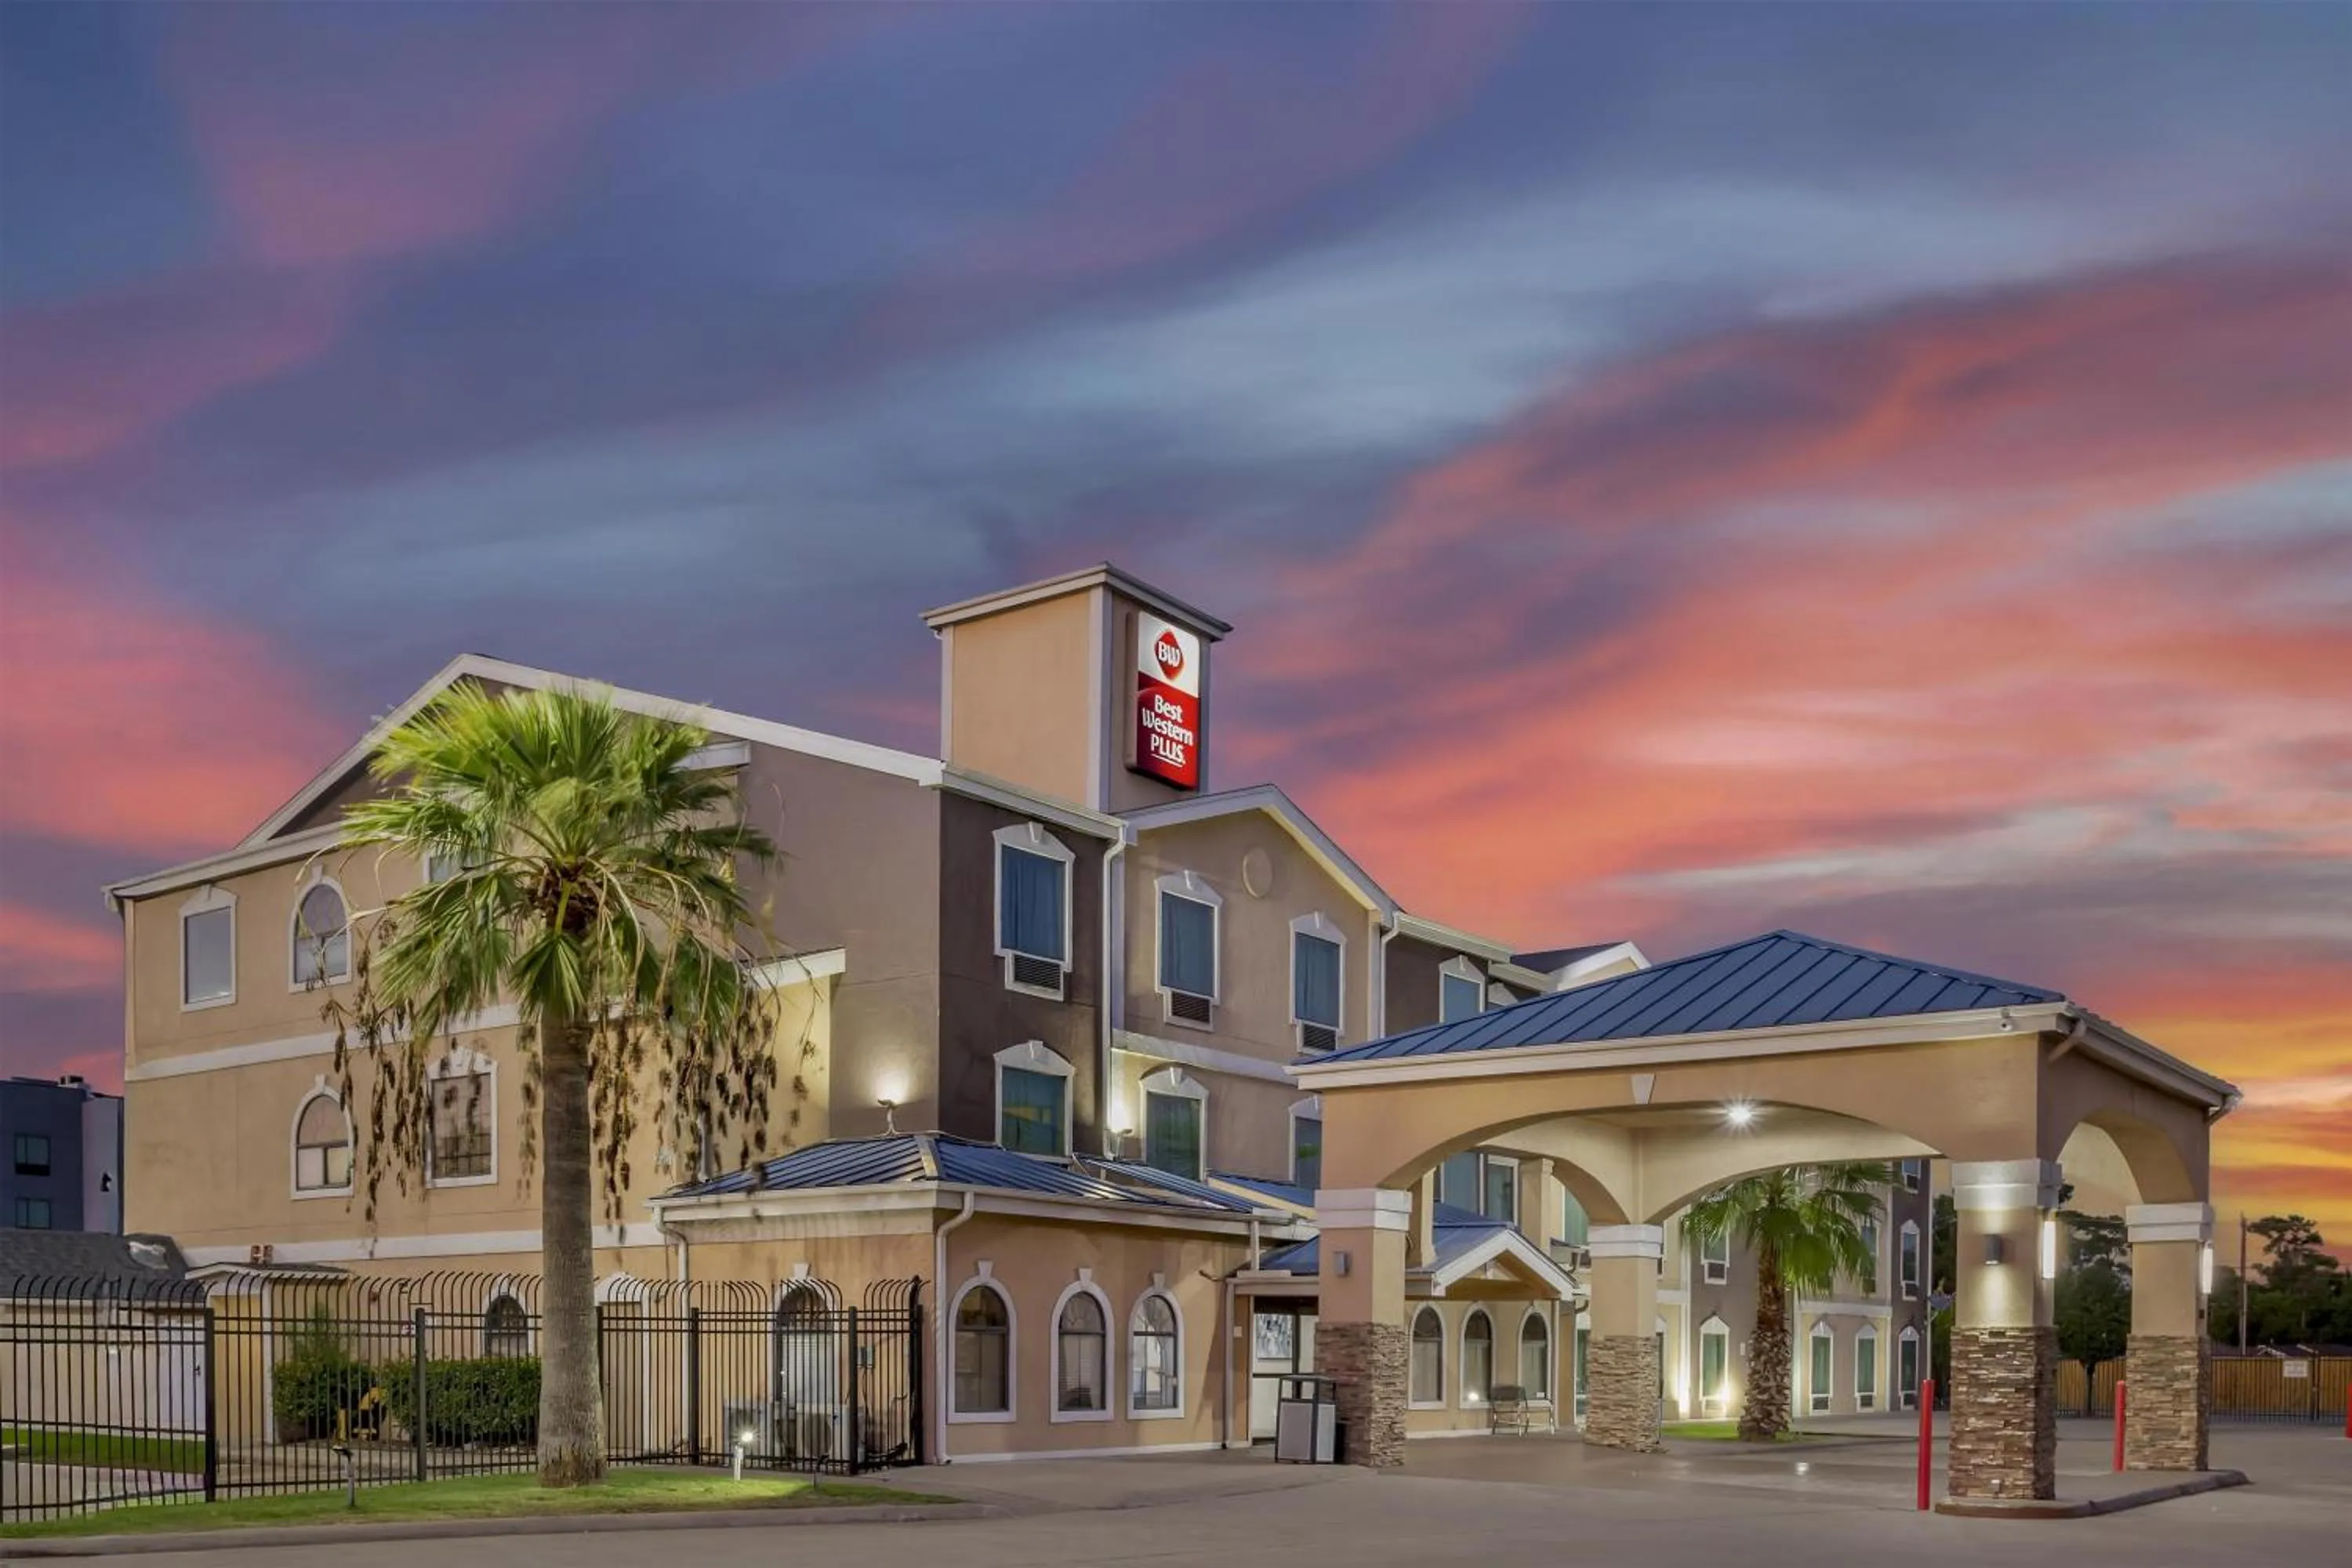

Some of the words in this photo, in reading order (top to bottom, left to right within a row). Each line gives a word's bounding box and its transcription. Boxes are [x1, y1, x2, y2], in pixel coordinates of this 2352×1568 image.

[1158, 641, 1181, 667] BW
[1155, 694, 1183, 723] Best
[1142, 707, 1193, 746] Western
[1151, 733, 1184, 763] PLUS
